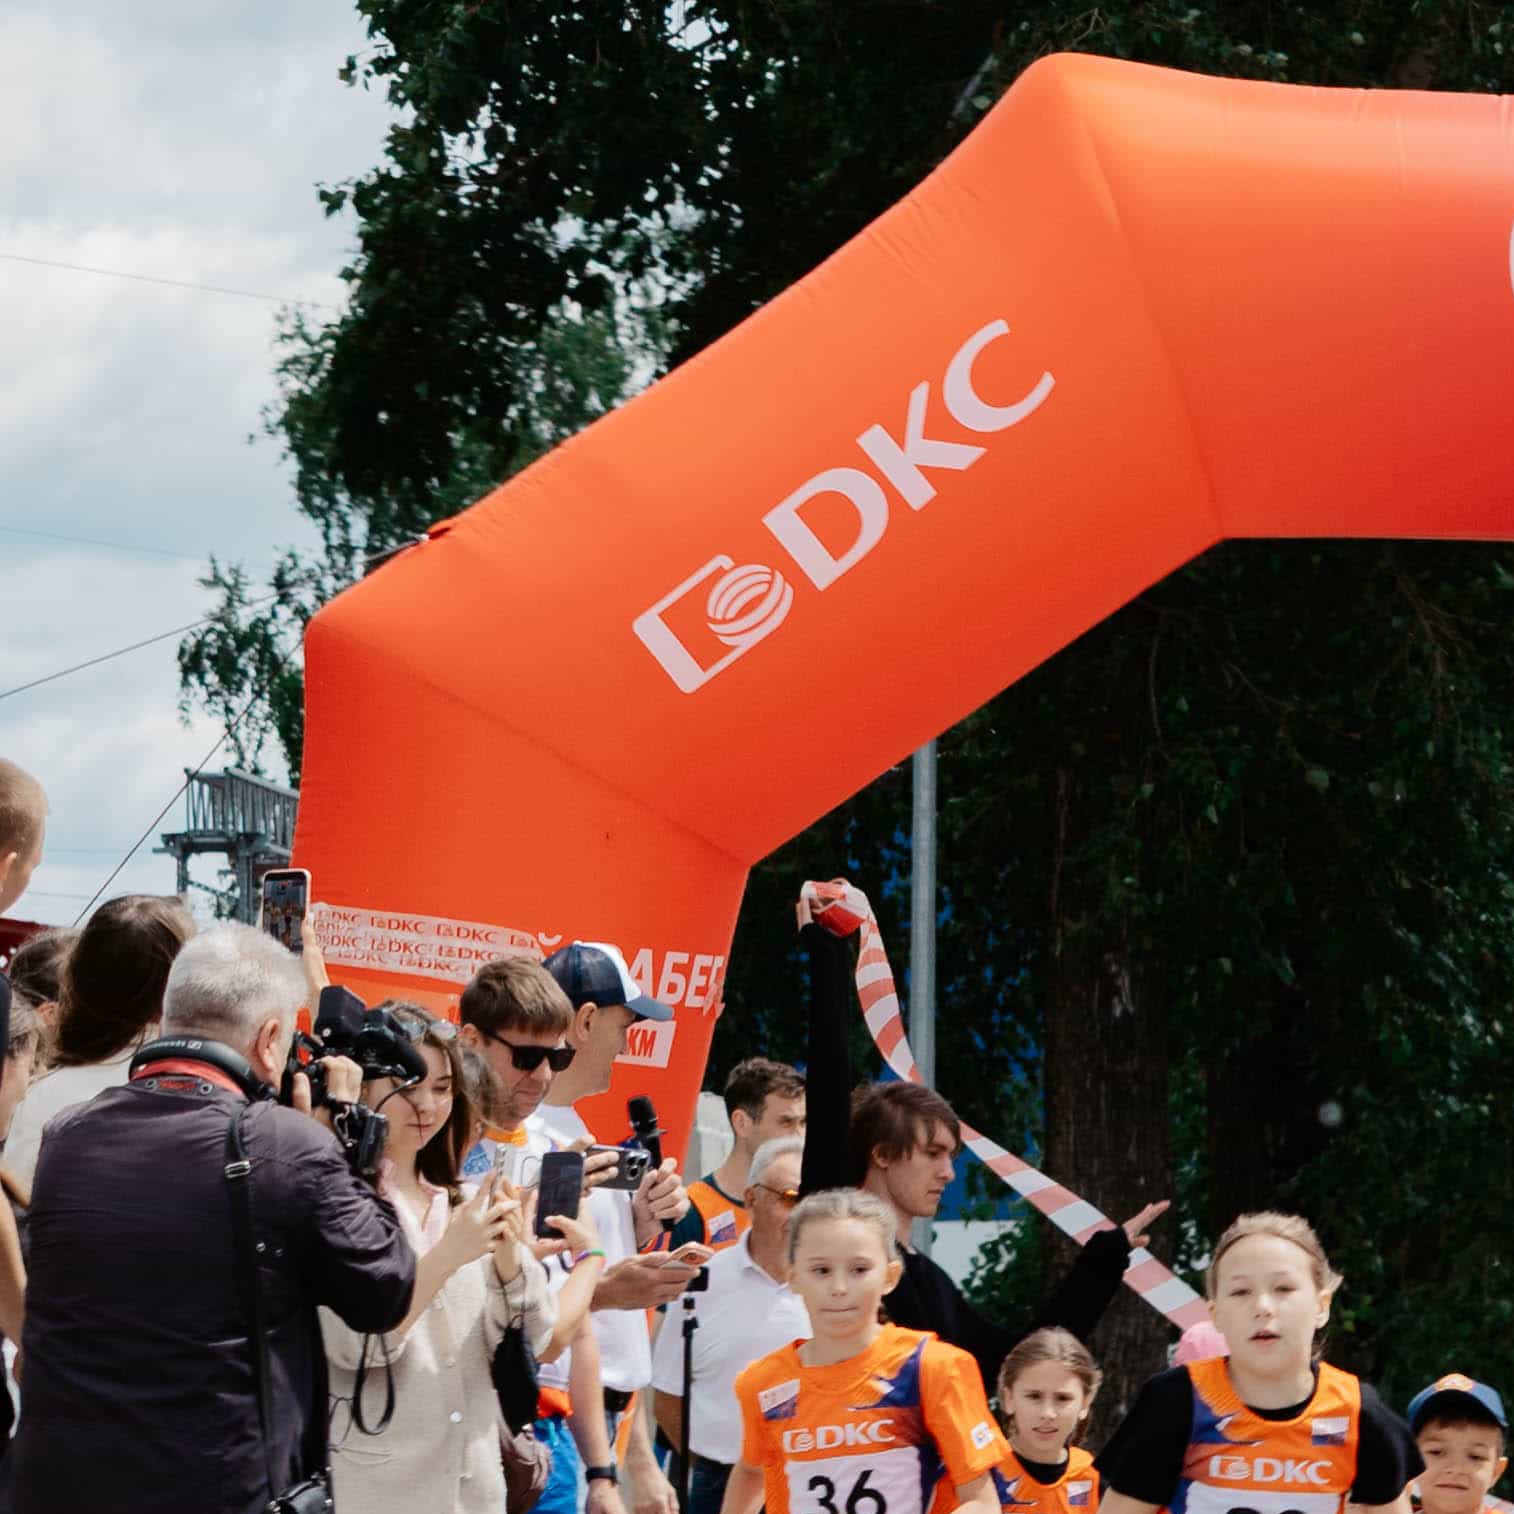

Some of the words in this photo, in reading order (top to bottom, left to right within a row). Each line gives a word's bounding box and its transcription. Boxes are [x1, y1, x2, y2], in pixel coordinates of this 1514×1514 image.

[761, 319, 1056, 592] DKC
[816, 1418, 897, 1451] DKC
[1253, 1457, 1333, 1485] DKC
